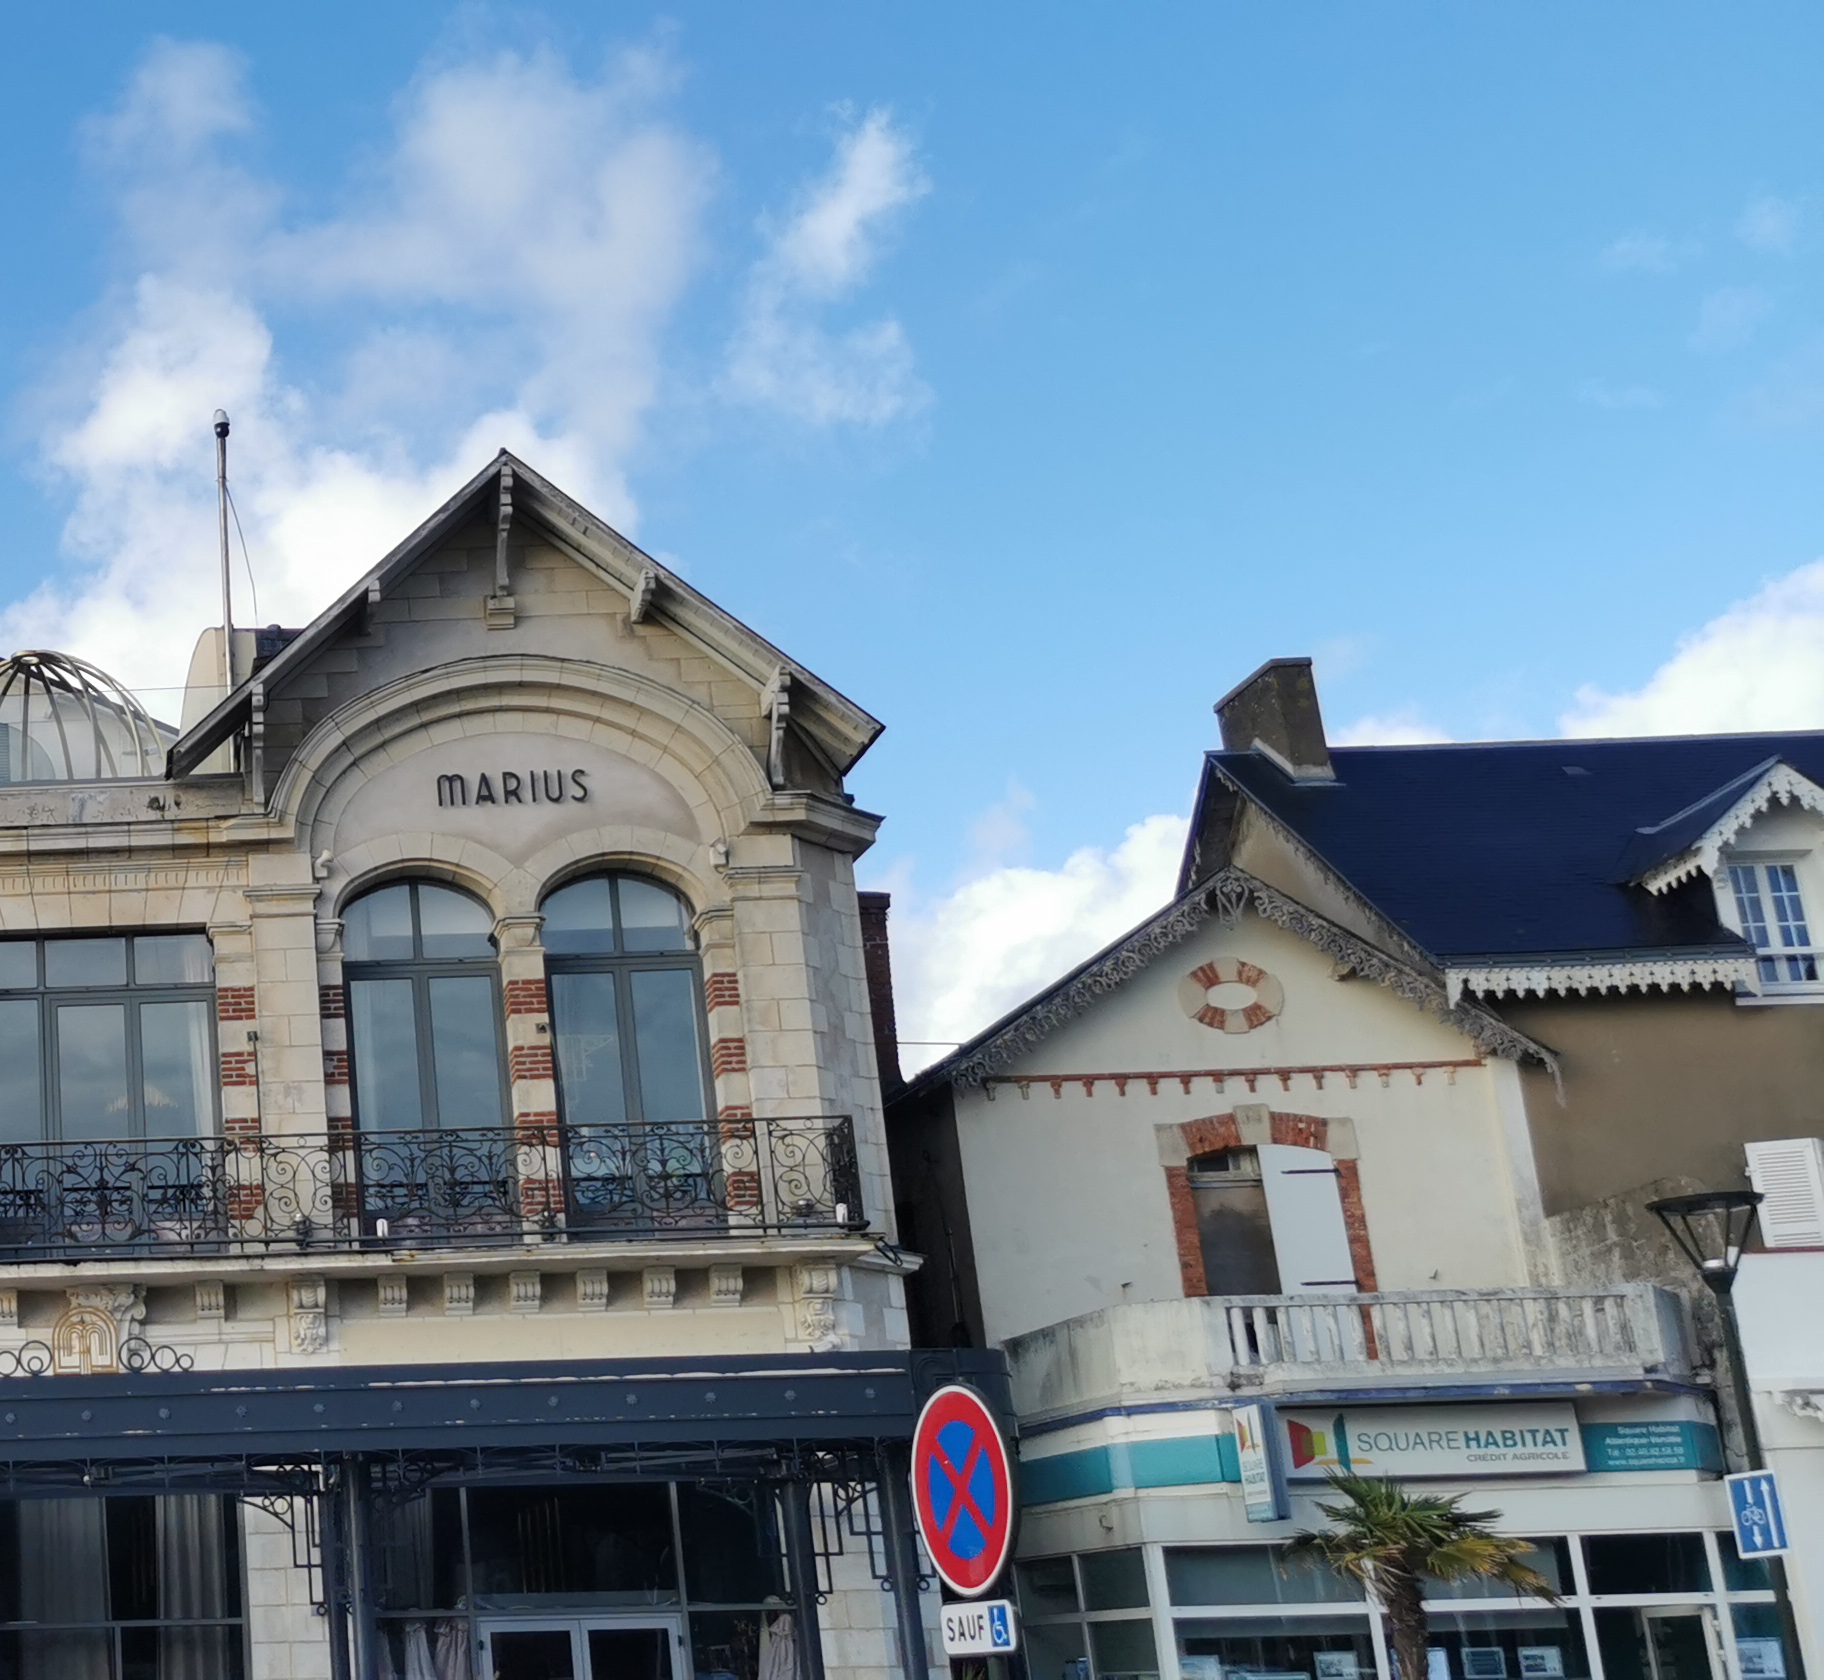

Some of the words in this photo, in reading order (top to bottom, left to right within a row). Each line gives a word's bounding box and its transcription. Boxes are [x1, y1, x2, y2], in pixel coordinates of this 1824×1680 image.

[436, 768, 589, 807] MARIUS
[1511, 1451, 1570, 1462] AGRICOLE
[946, 1613, 984, 1642] SAUF
